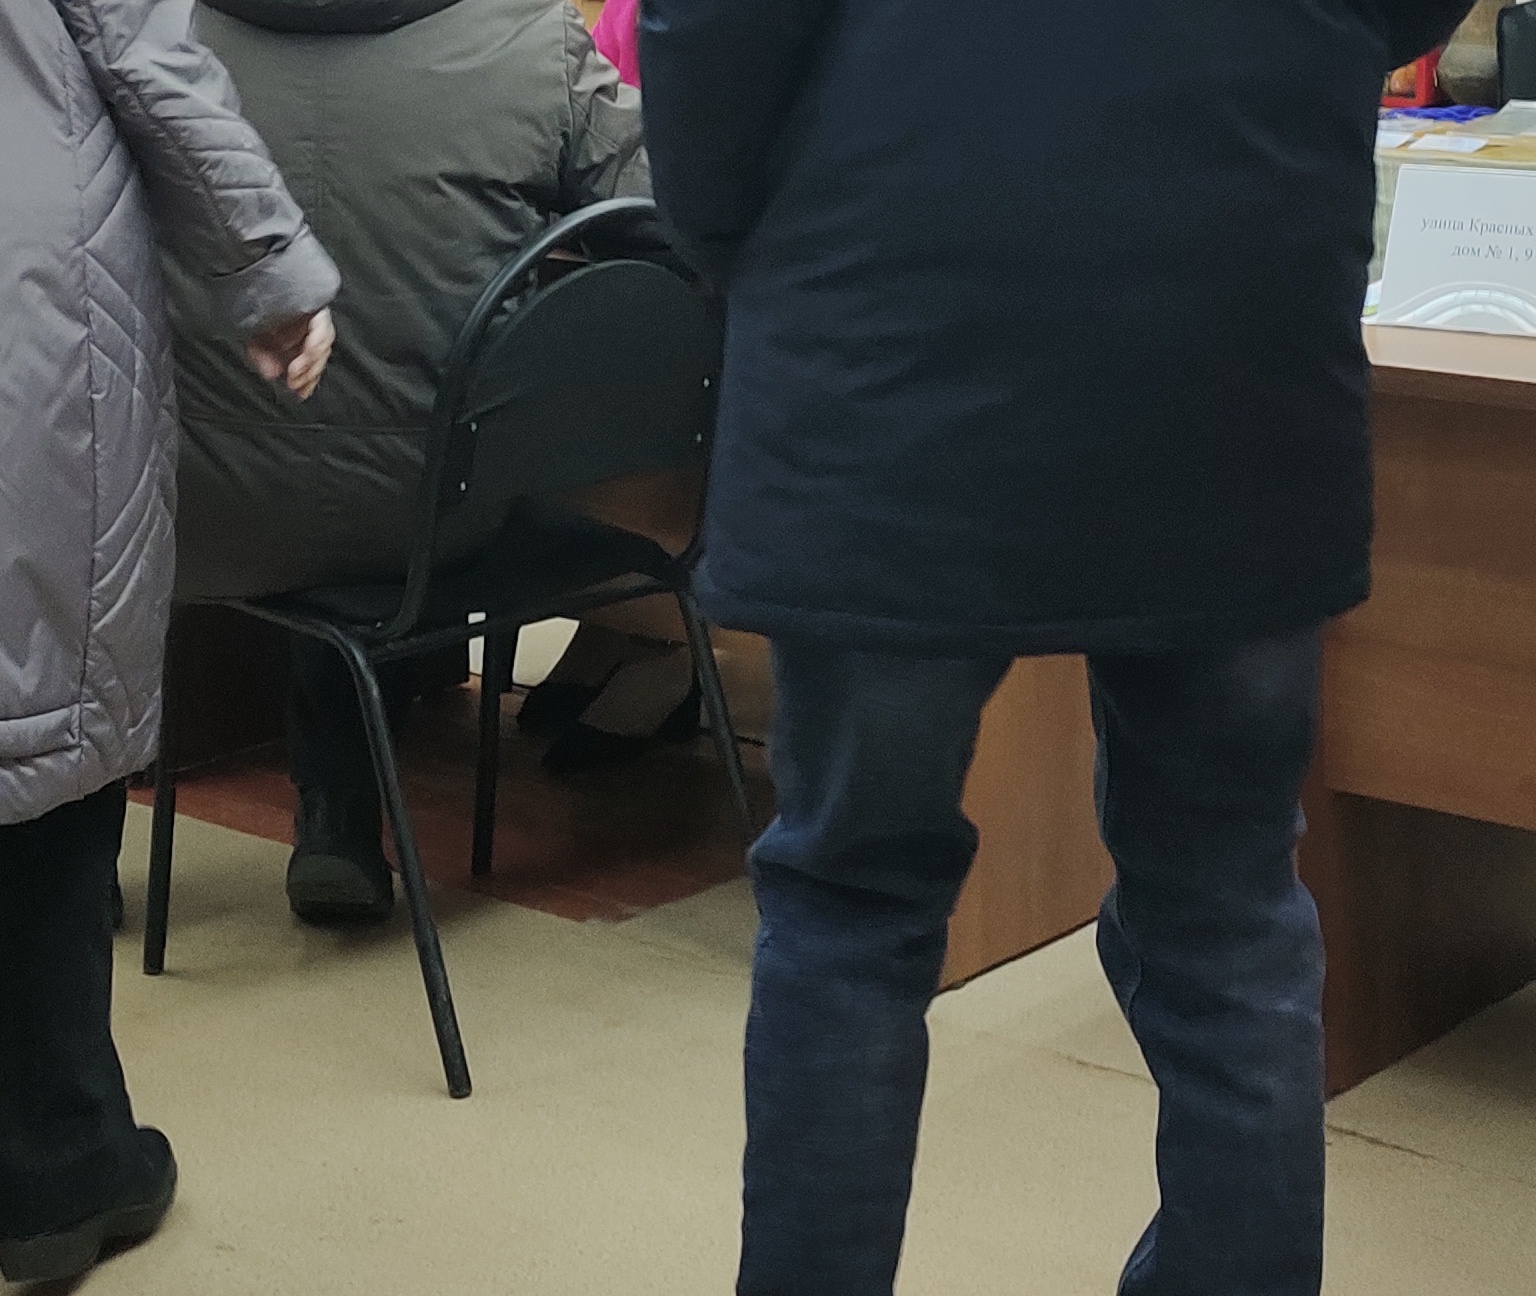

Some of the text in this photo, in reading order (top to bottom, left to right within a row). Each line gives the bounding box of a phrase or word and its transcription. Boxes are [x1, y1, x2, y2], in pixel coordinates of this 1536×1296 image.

[1420, 215, 1464, 233] улица
[1468, 217, 1534, 237] Красных
[1450, 245, 1482, 260] дом
[1485, 244, 1502, 260] №
[1524, 246, 1534, 262] 9
